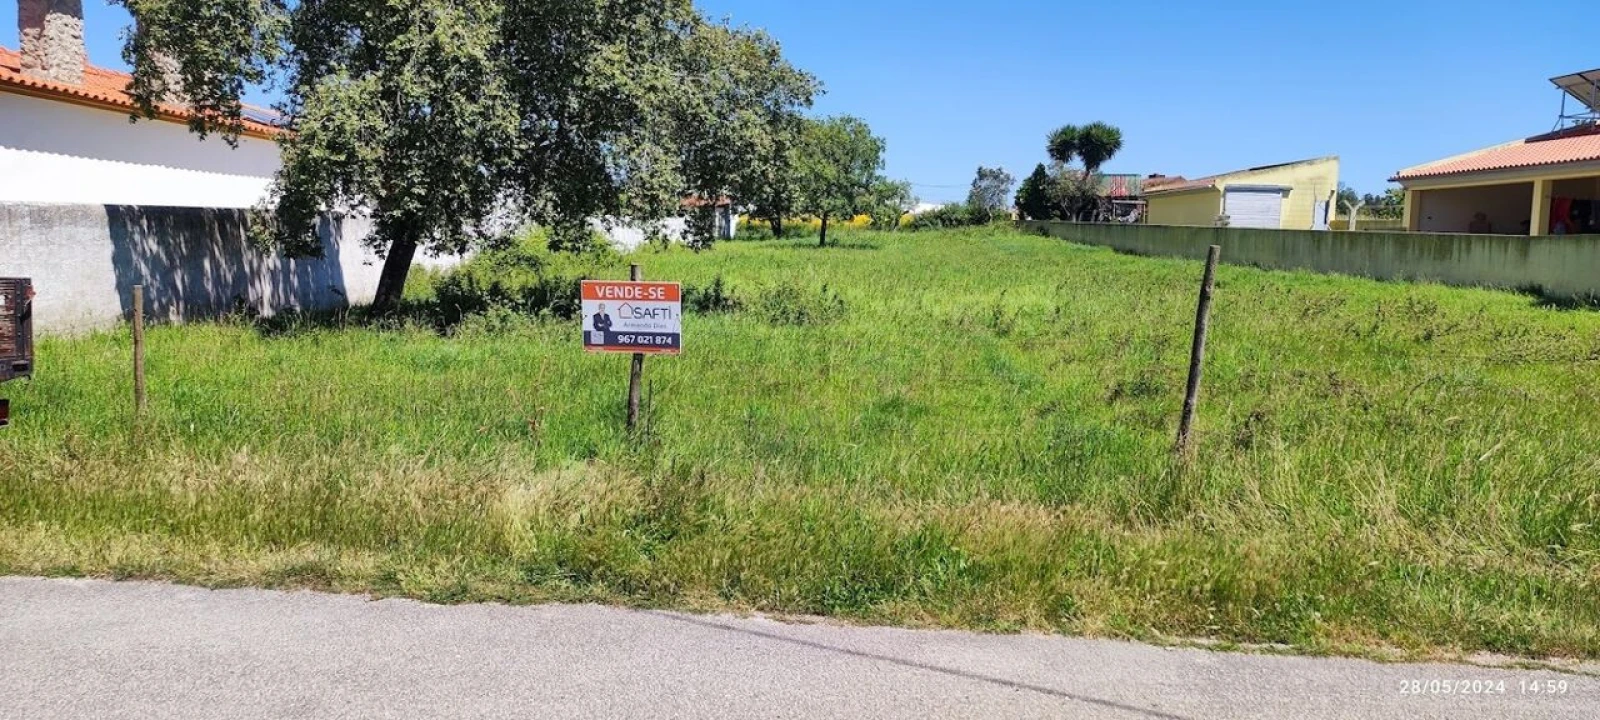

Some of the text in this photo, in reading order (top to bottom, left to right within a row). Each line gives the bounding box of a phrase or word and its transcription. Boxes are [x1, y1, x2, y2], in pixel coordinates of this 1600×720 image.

[595, 285, 666, 300] VENDE-SE
[617, 334, 672, 345] 967 021 874
